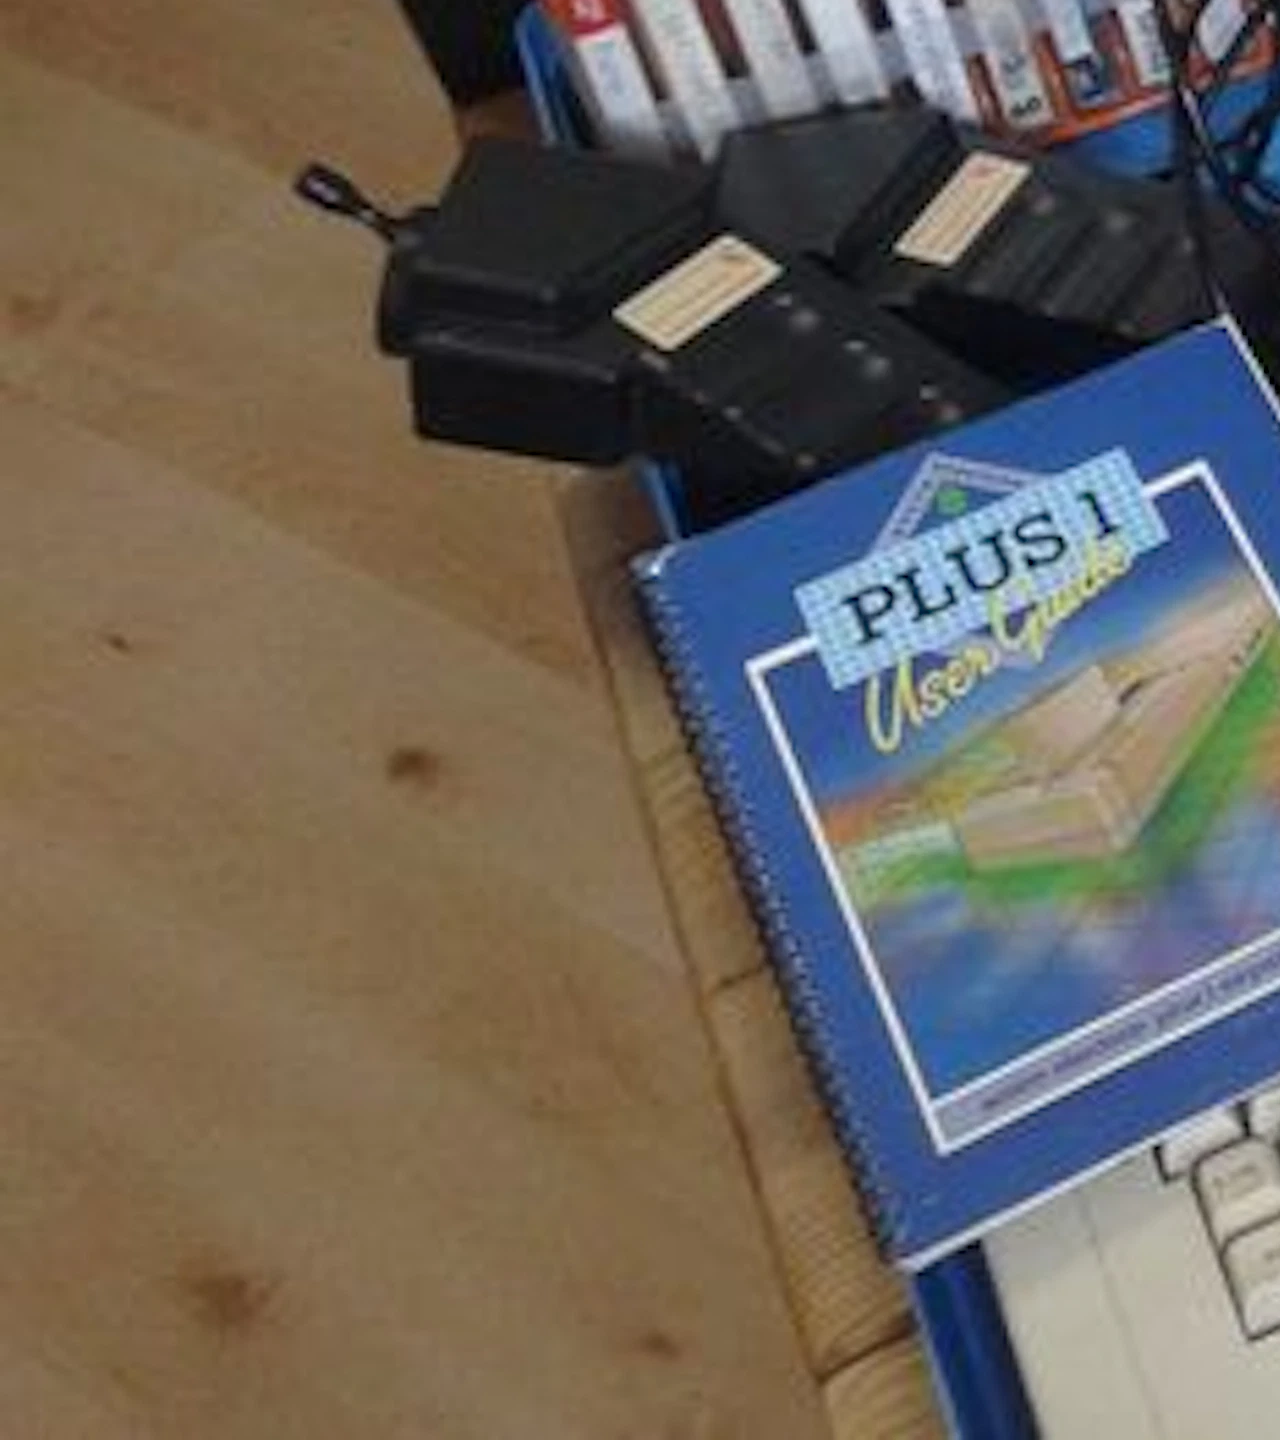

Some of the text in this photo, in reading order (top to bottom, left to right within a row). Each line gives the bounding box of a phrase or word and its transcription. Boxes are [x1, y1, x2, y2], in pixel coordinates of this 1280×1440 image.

[844, 490, 1125, 648] PLUS 1
[864, 643, 998, 753] User
